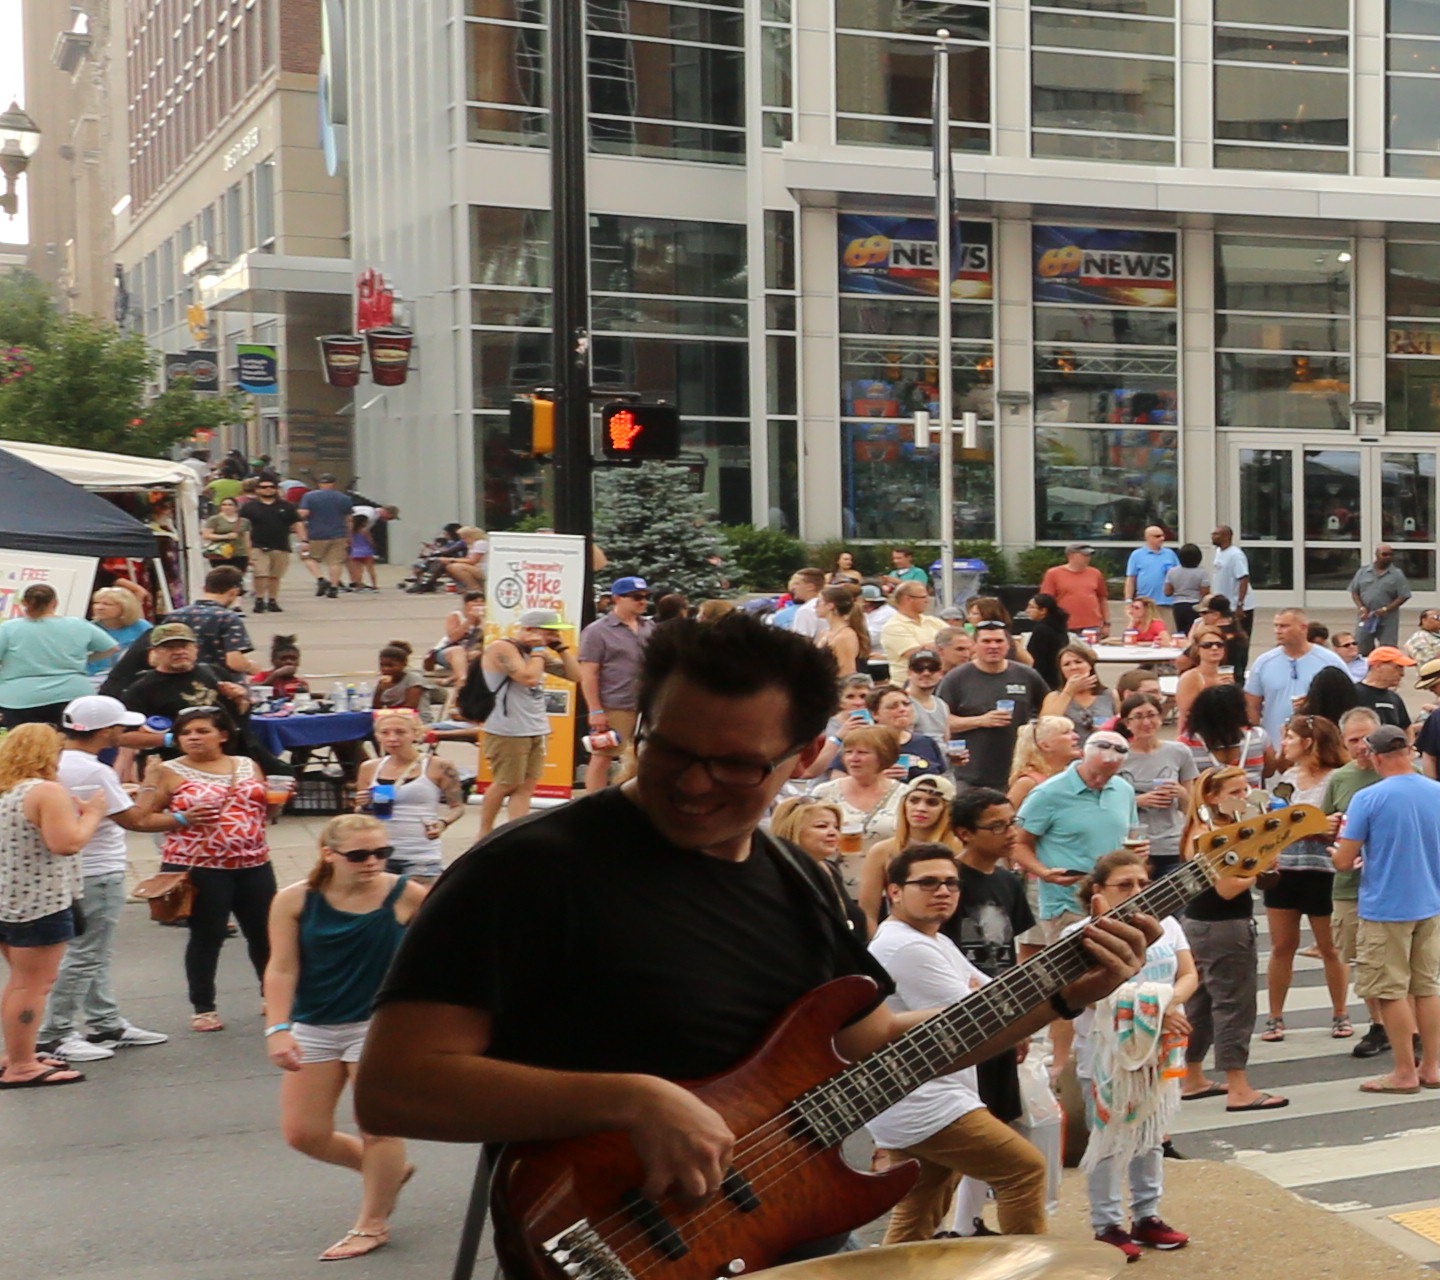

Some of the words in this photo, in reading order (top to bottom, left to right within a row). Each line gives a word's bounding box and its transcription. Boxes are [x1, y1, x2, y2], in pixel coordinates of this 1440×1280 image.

[1083, 252, 1174, 279] NEWS
[20, 567, 49, 581] FREE
[526, 572, 561, 595] Bike
[525, 594, 564, 612] Works
